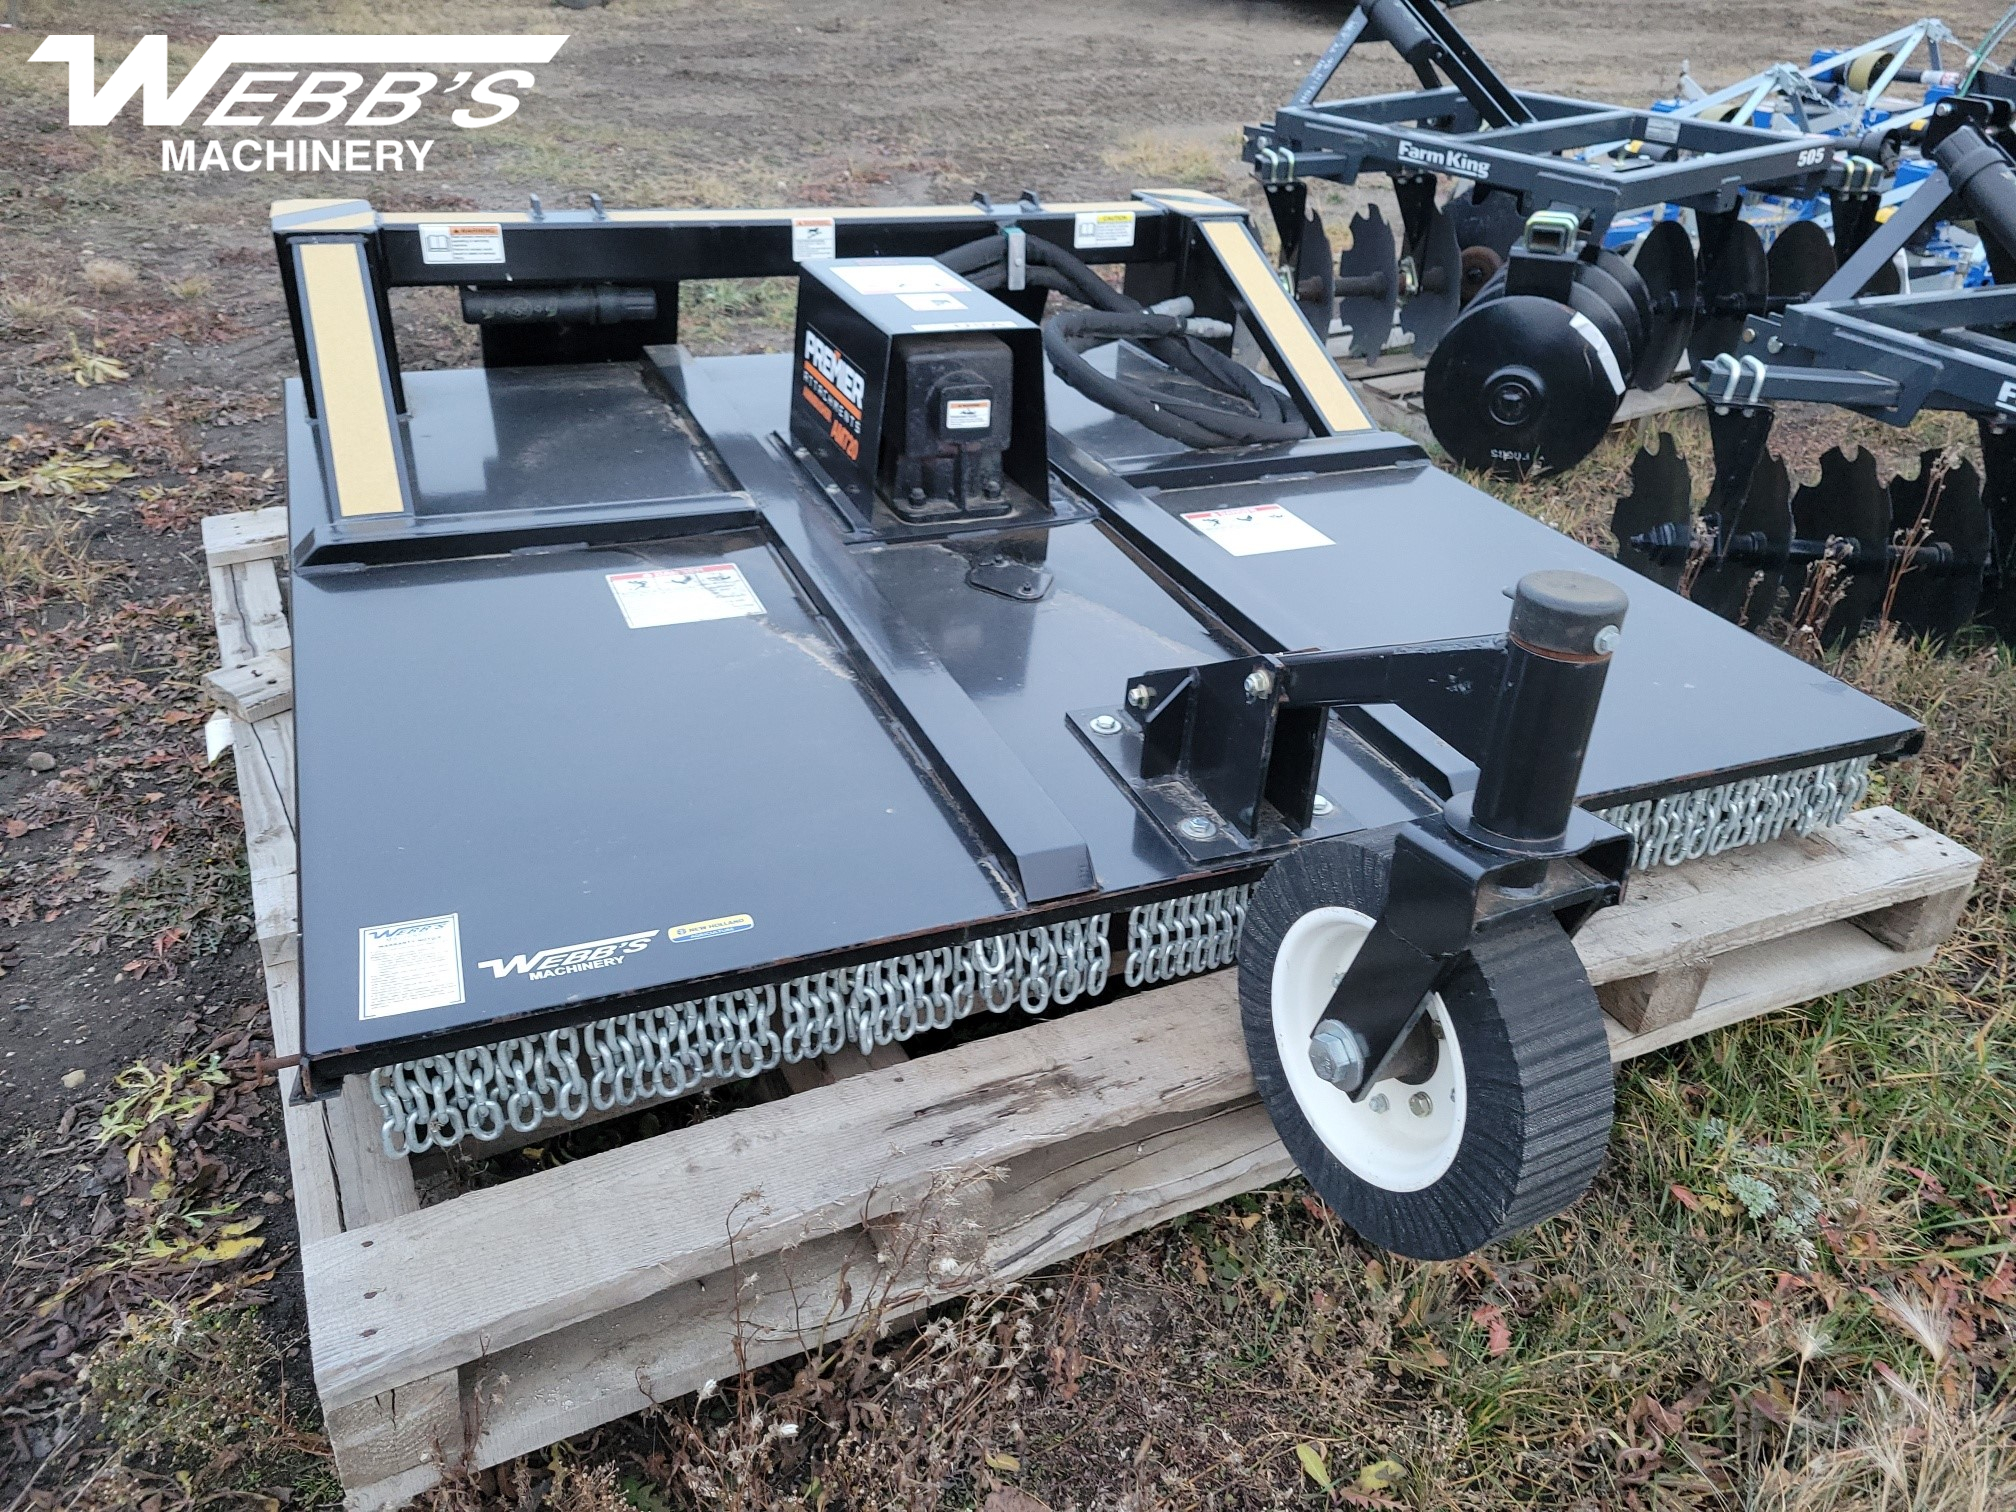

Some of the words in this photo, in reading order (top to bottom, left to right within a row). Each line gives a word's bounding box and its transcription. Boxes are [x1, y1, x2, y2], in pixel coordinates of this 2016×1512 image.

[1398, 140, 1445, 165] Farm
[1446, 150, 1491, 179] King
[1796, 147, 1826, 168] 505
[804, 330, 866, 410] PREMIER
[688, 924, 708, 933] NEW
[708, 918, 745, 930] HOLLAND
[478, 929, 661, 979] WEBB'S
[529, 955, 625, 981] MACHINERY
